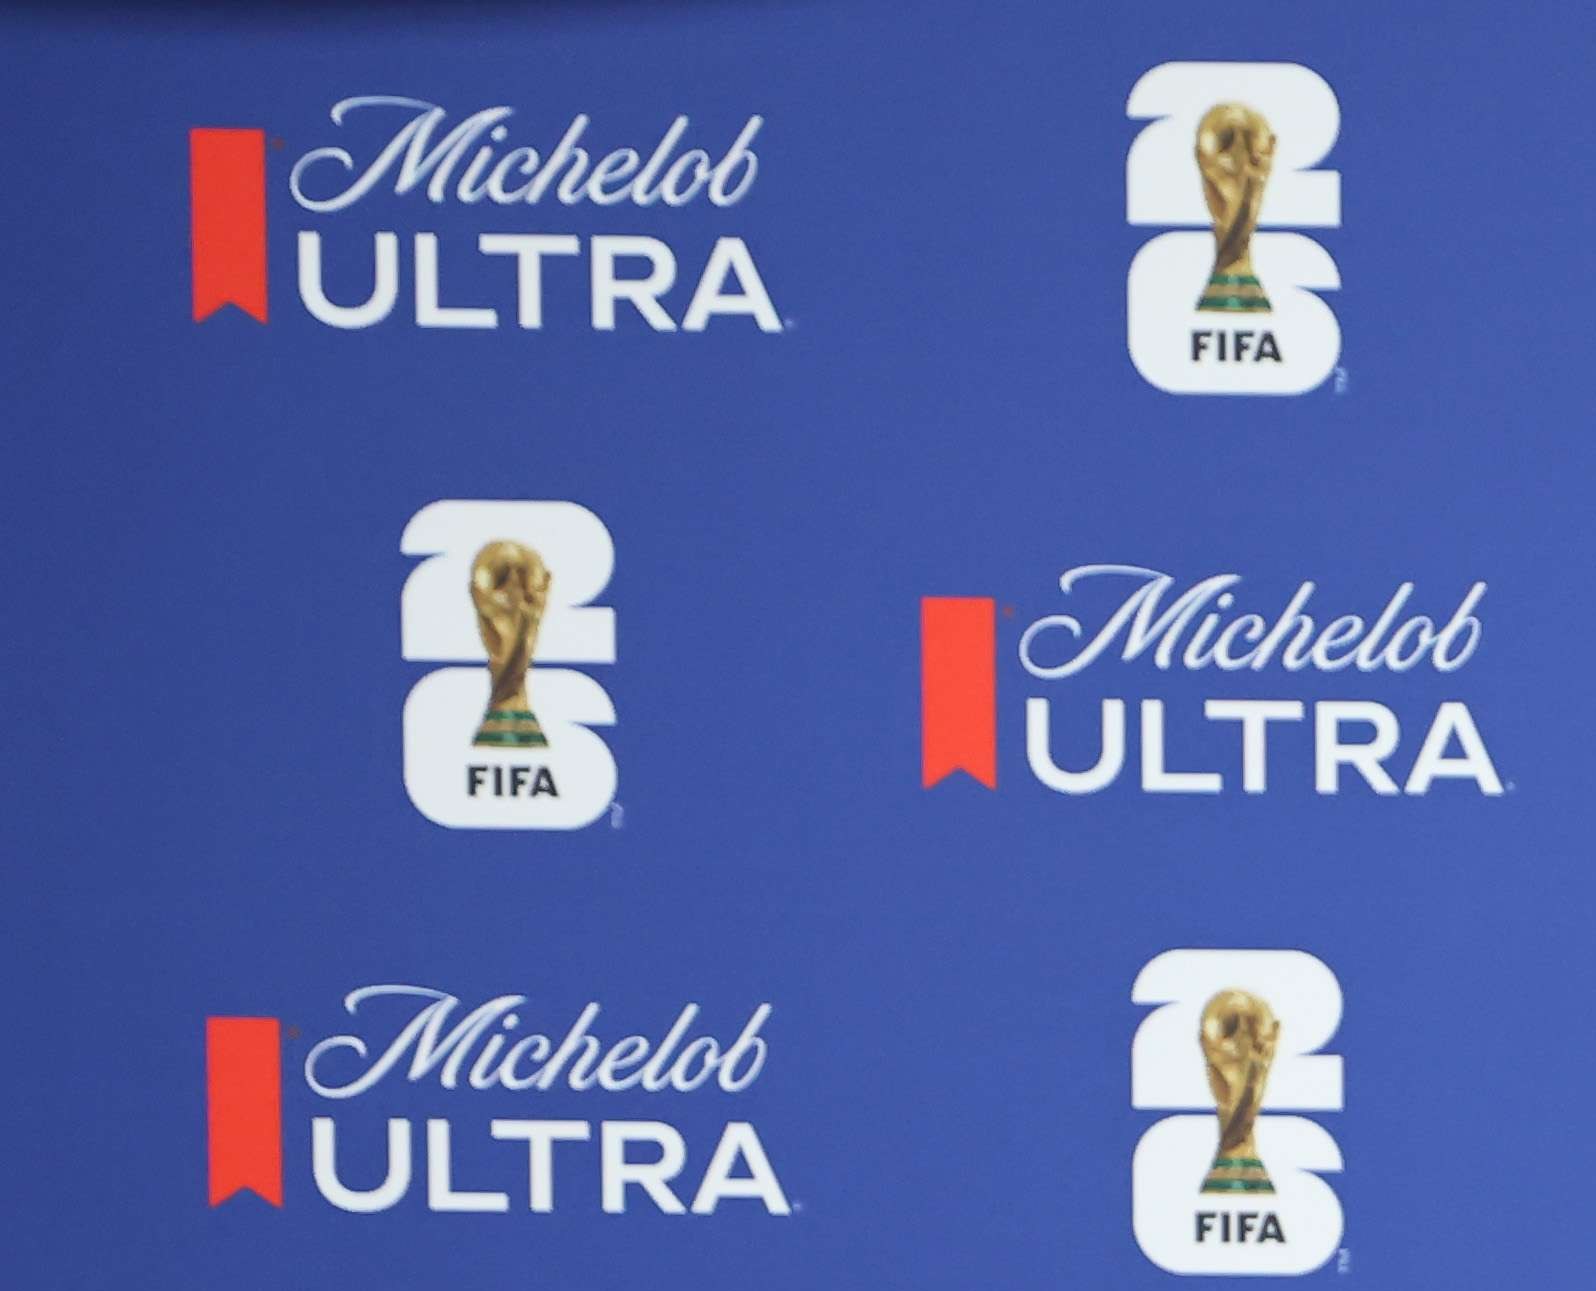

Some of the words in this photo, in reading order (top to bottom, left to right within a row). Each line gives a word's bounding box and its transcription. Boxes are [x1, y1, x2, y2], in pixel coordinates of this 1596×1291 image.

[290, 95, 763, 212] Michelob
[298, 231, 782, 332] ULTRA
[1191, 331, 1282, 363] FIFA
[1020, 565, 1486, 678] Michelob
[468, 766, 559, 797] FIFA
[1027, 698, 1504, 795] ULTRA
[305, 985, 772, 1098] Michelob
[312, 1118, 791, 1215] ULTRA
[1196, 1212, 1286, 1243] FIFA
